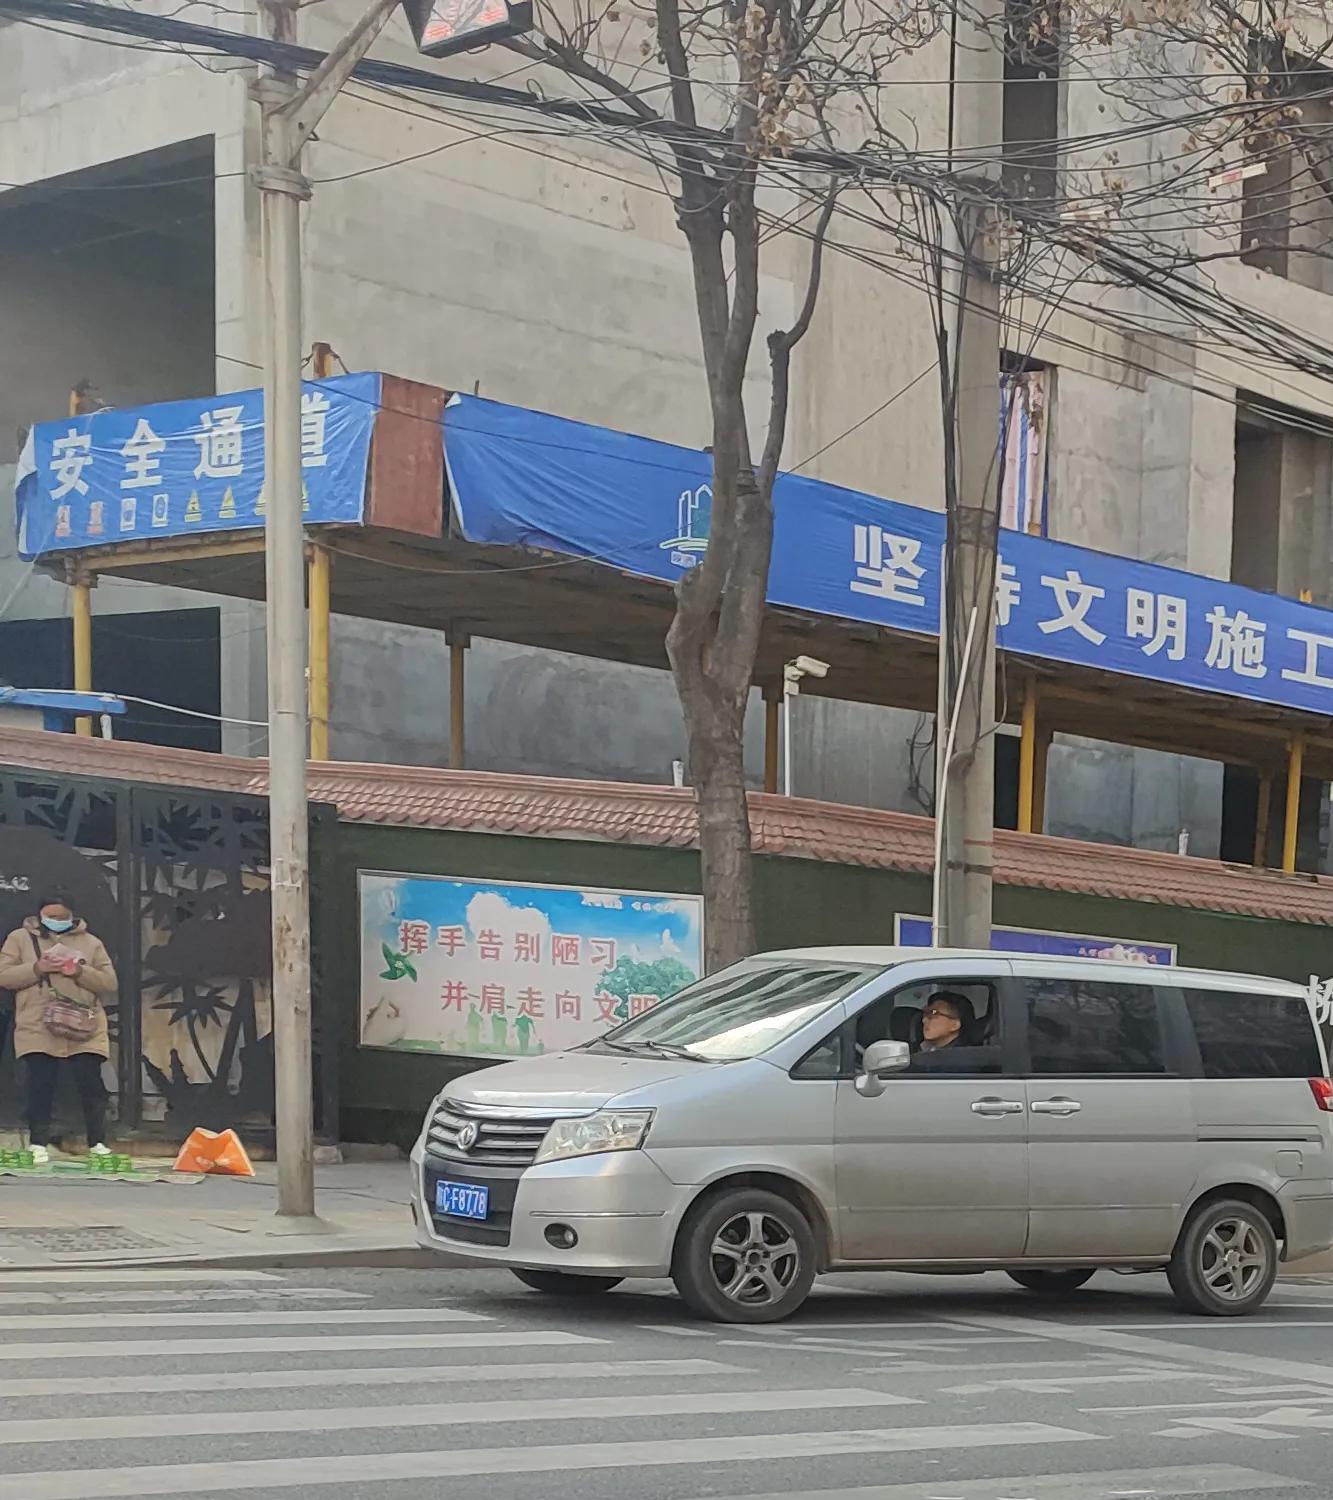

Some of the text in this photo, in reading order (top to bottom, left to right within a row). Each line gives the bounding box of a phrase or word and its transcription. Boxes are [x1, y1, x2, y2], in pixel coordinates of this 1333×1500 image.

[50, 392, 331, 500] 安全通道
[399, 921, 618, 969] 挥手告别陋习
[441, 981, 658, 1026] 并肩走向文明
